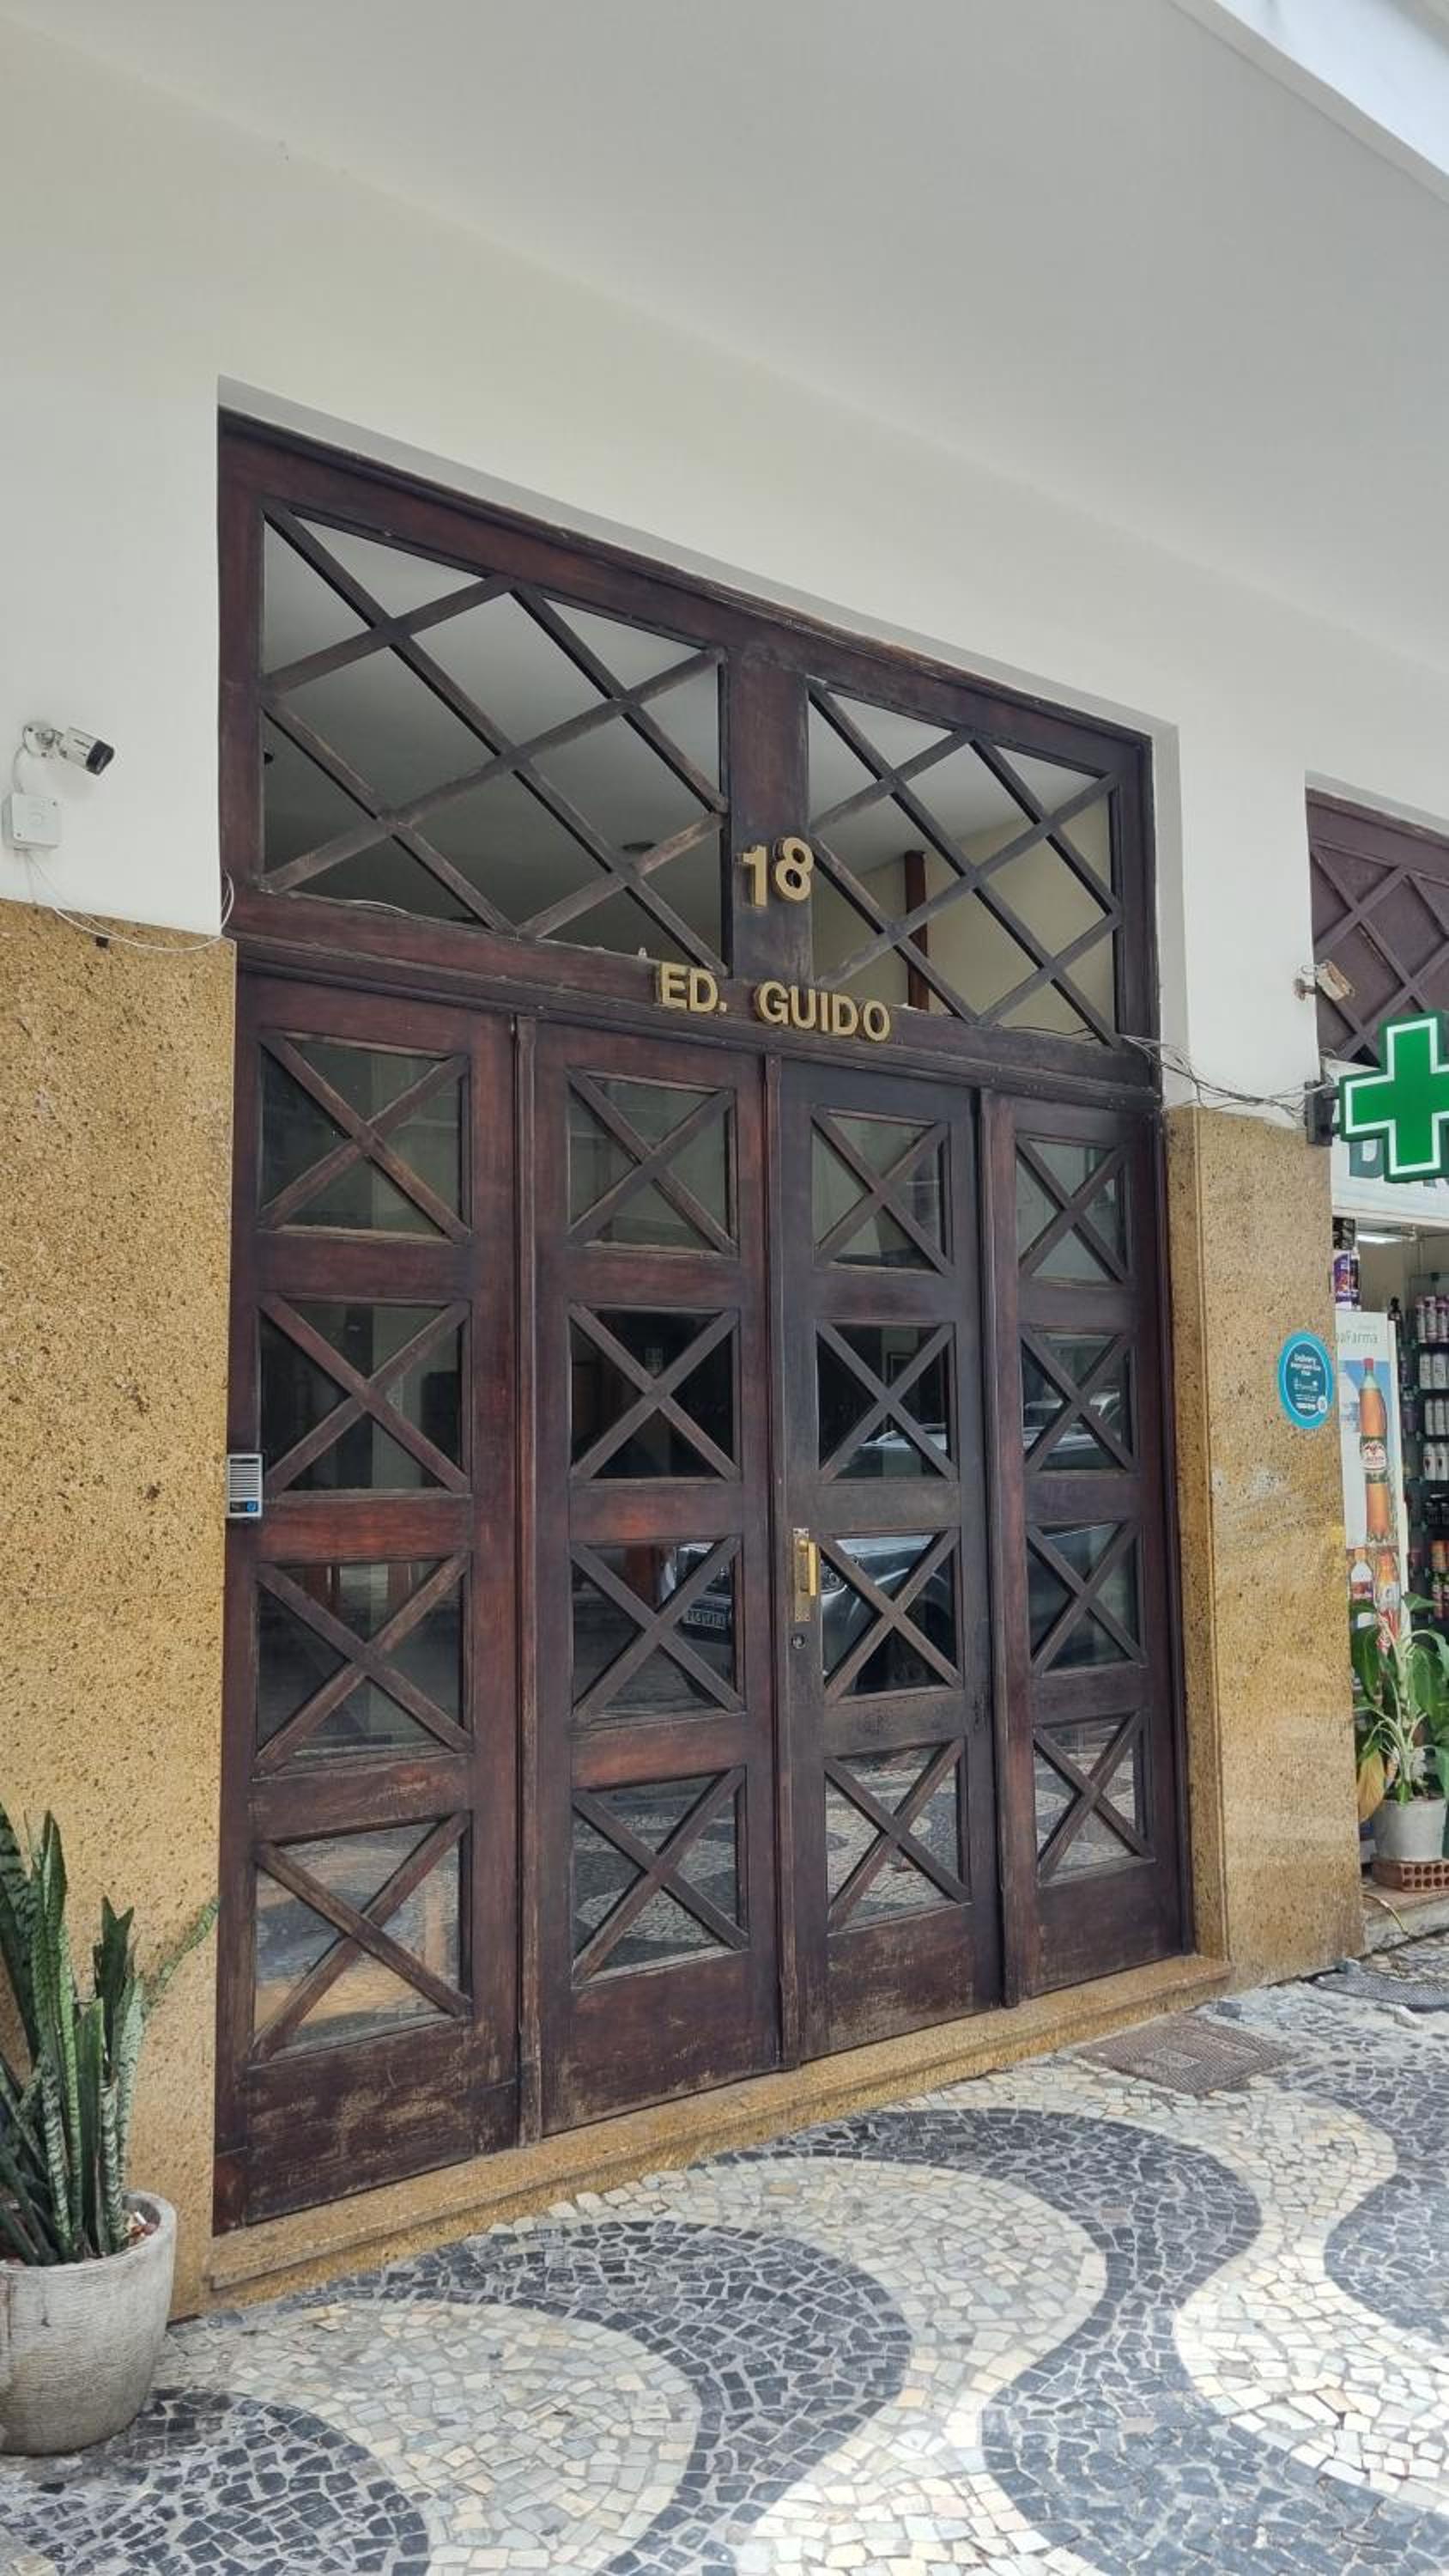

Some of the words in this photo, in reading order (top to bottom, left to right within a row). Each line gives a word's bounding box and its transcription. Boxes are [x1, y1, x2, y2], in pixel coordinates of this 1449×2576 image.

[742, 836, 815, 908] 18
[658, 963, 728, 1013] ED.
[755, 981, 891, 1042] GUIDO
